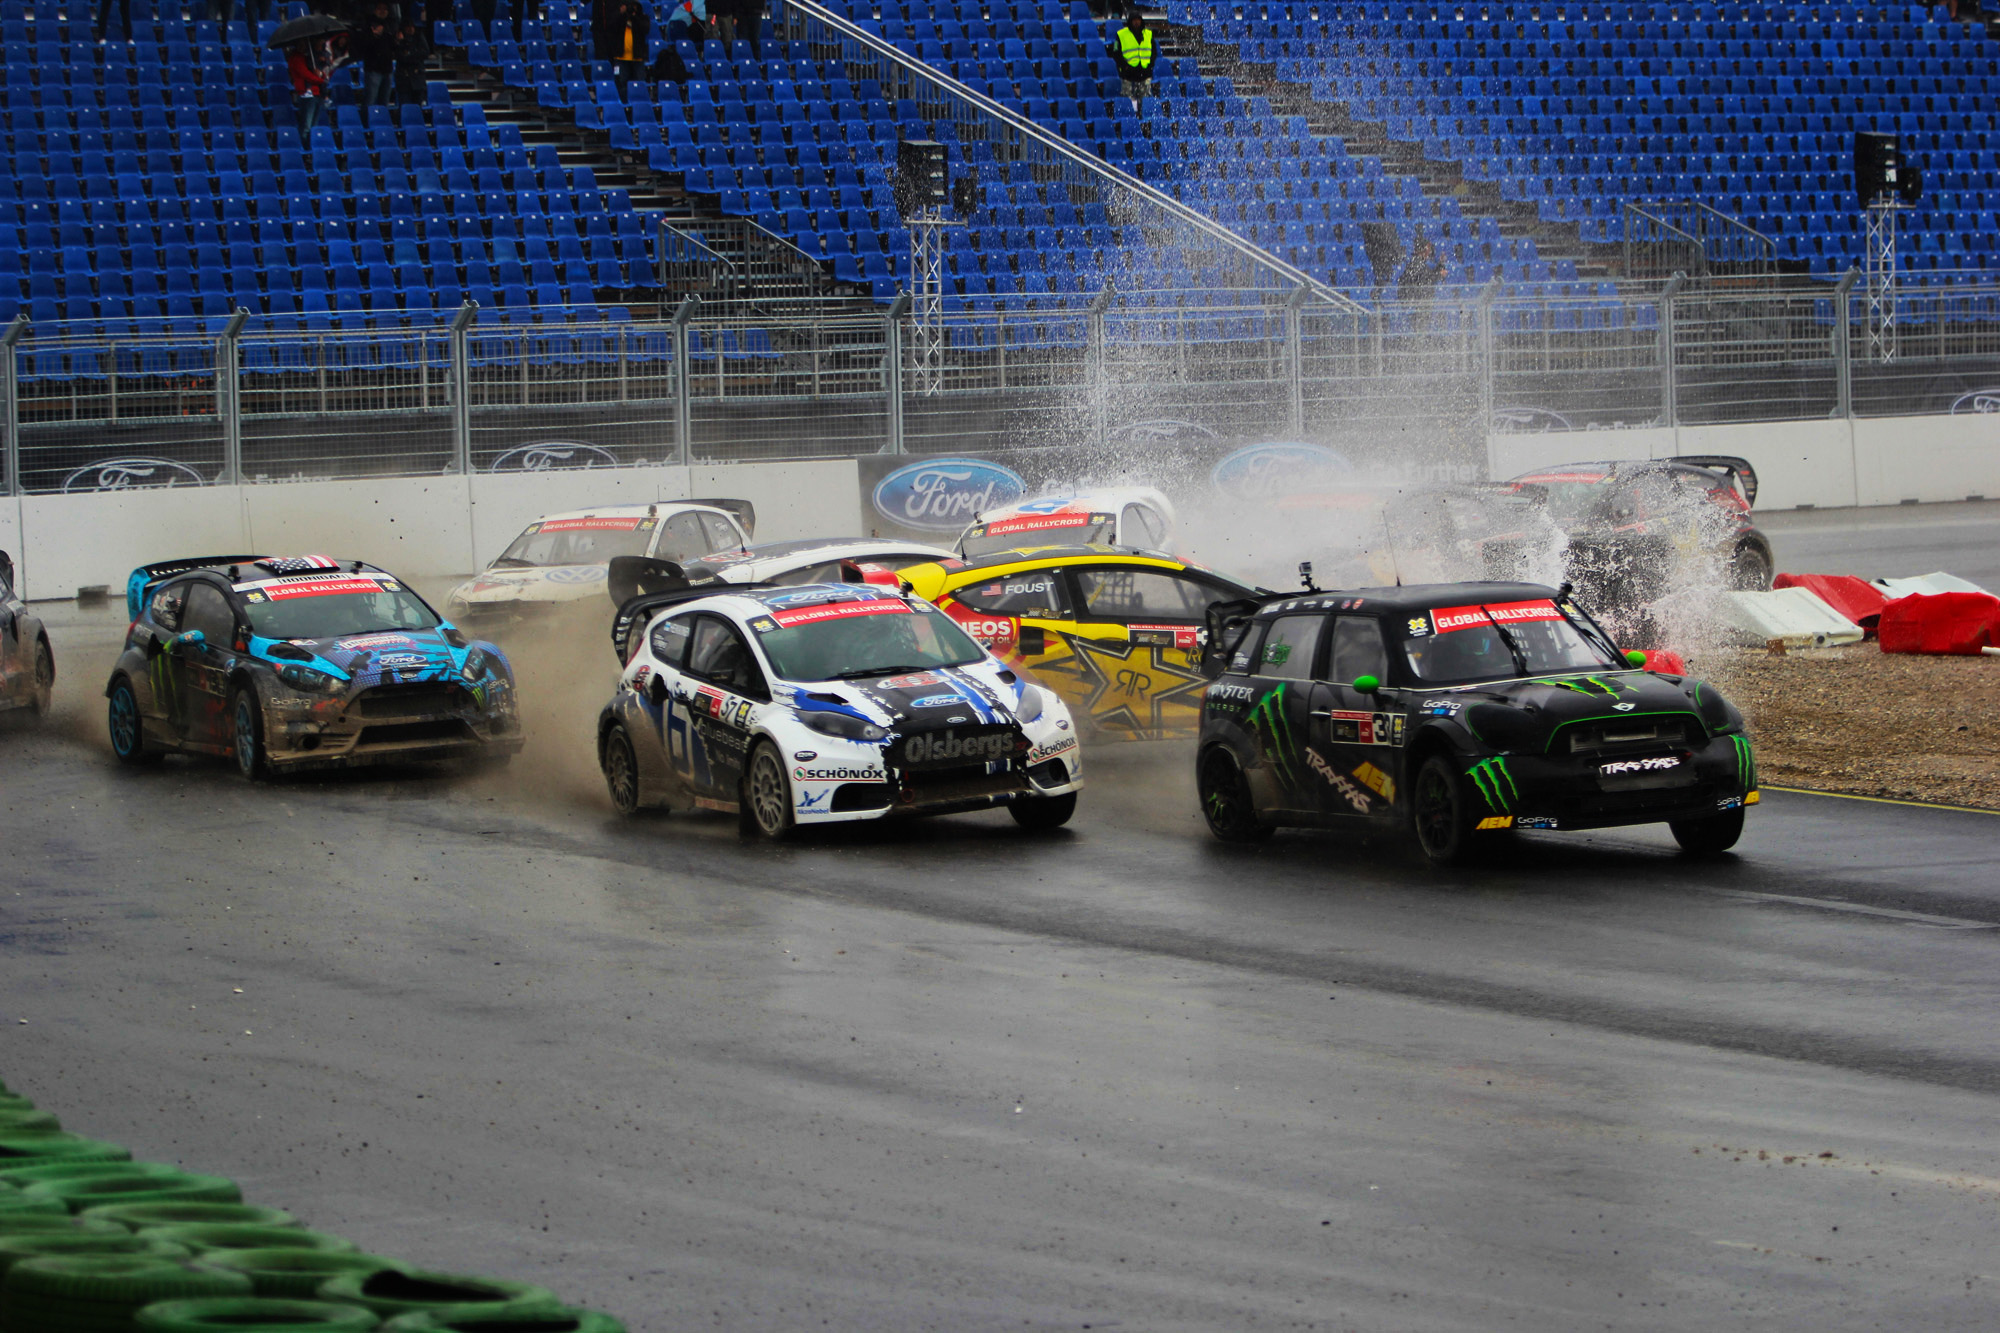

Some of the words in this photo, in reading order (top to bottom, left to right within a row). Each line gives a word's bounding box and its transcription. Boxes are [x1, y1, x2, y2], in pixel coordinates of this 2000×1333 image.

[905, 471, 995, 517] Ford
[554, 521, 585, 530] GLOBAL
[585, 521, 635, 529] RALLYCROSS
[990, 523, 1026, 534] GLOBAL
[1027, 518, 1084, 529] RALLYCROSS
[267, 586, 310, 597] GLOBAL
[311, 582, 380, 592] RALLYCROSS
[1005, 582, 1054, 595] FOUST
[796, 610, 836, 621] GLOBAL
[838, 603, 906, 615] RALLYCROSS
[1437, 612, 1490, 628] GLOBAL
[1489, 607, 1561, 621] RALLYCROSS
[379, 653, 417, 665] Ford
[271, 697, 312, 706] GoPro
[924, 696, 959, 706] Ford
[1423, 699, 1461, 709] GoPro
[904, 729, 1014, 762] Olsbergs
[1039, 736, 1076, 758] SCHÖNOX
[807, 767, 884, 779] SCHÖNOX
[1305, 746, 1371, 814] TRAXXAS
[1476, 815, 1513, 830] AEM
[1517, 817, 1558, 825] GoPro
